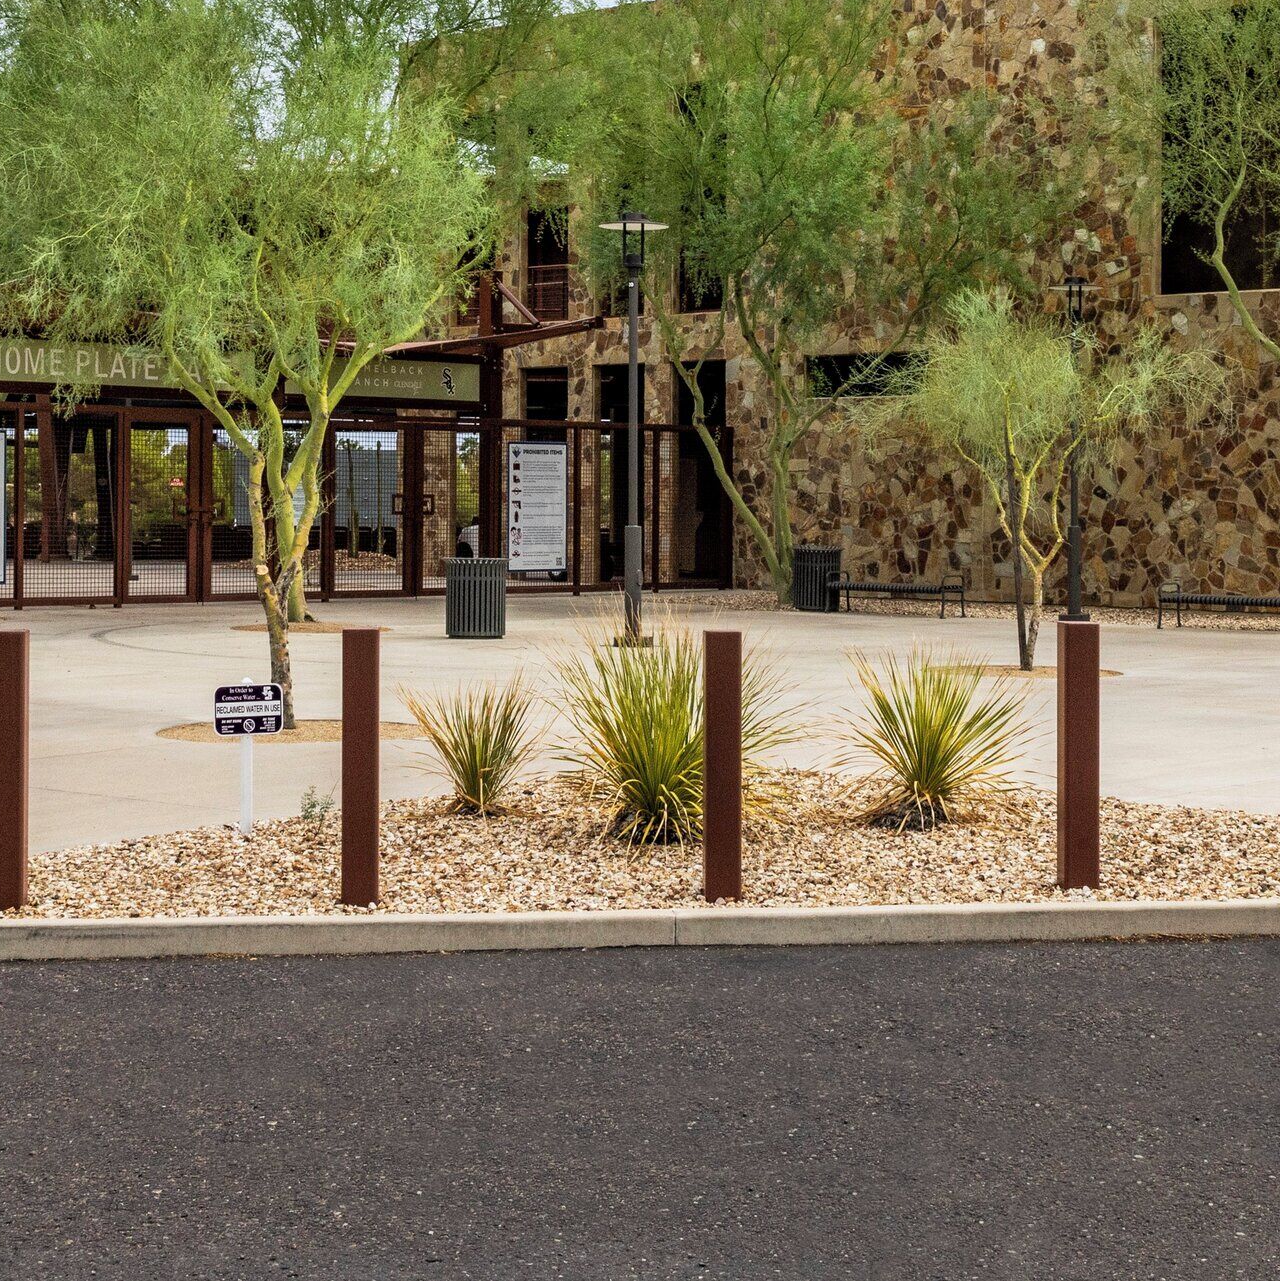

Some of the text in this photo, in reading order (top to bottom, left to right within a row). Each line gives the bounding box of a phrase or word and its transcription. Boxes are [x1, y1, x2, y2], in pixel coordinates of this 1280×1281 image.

[76, 349, 159, 381] PLATE
[363, 365, 424, 375] MELBACK
[355, 378, 389, 387] ANCH
[217, 703, 280, 714] RECLAIMED WATER IN USE
